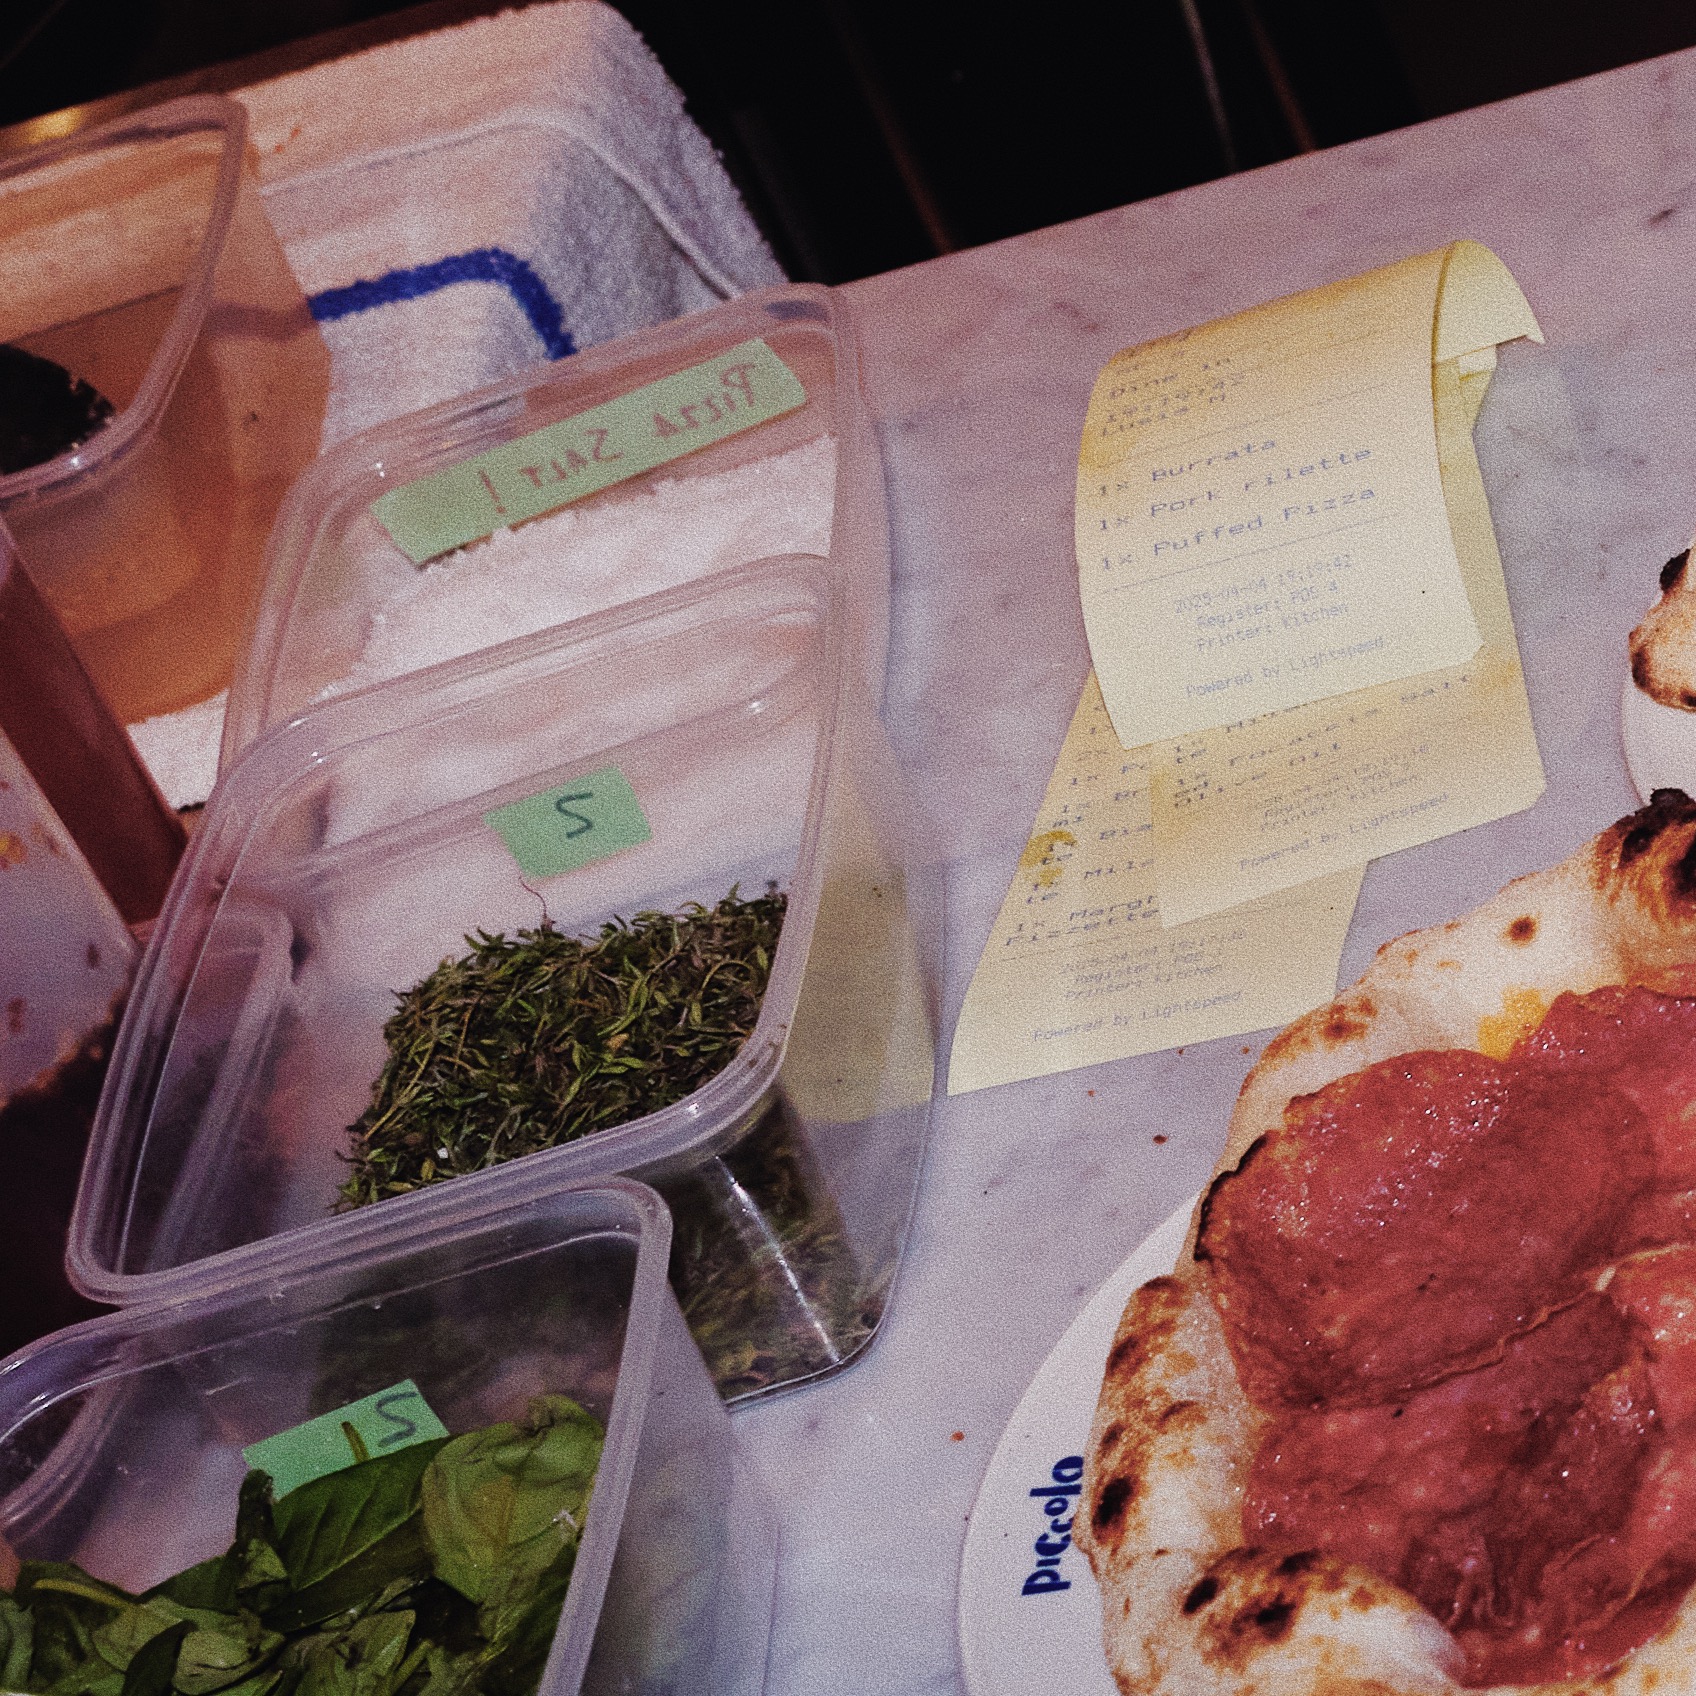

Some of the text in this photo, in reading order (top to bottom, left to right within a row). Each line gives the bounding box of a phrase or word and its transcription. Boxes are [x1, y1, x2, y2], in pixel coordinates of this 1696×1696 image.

[1099, 439, 1277, 498] 1x Burrata
[1099, 448, 1371, 532] 1x Pork rilette
[1101, 487, 1375, 571] 1x Puffed Pizza
[1185, 634, 1385, 699] Powered by Lightspeed
[1032, 1017, 1104, 1042] Powered
[1139, 988, 1243, 1021] Lightspeed
